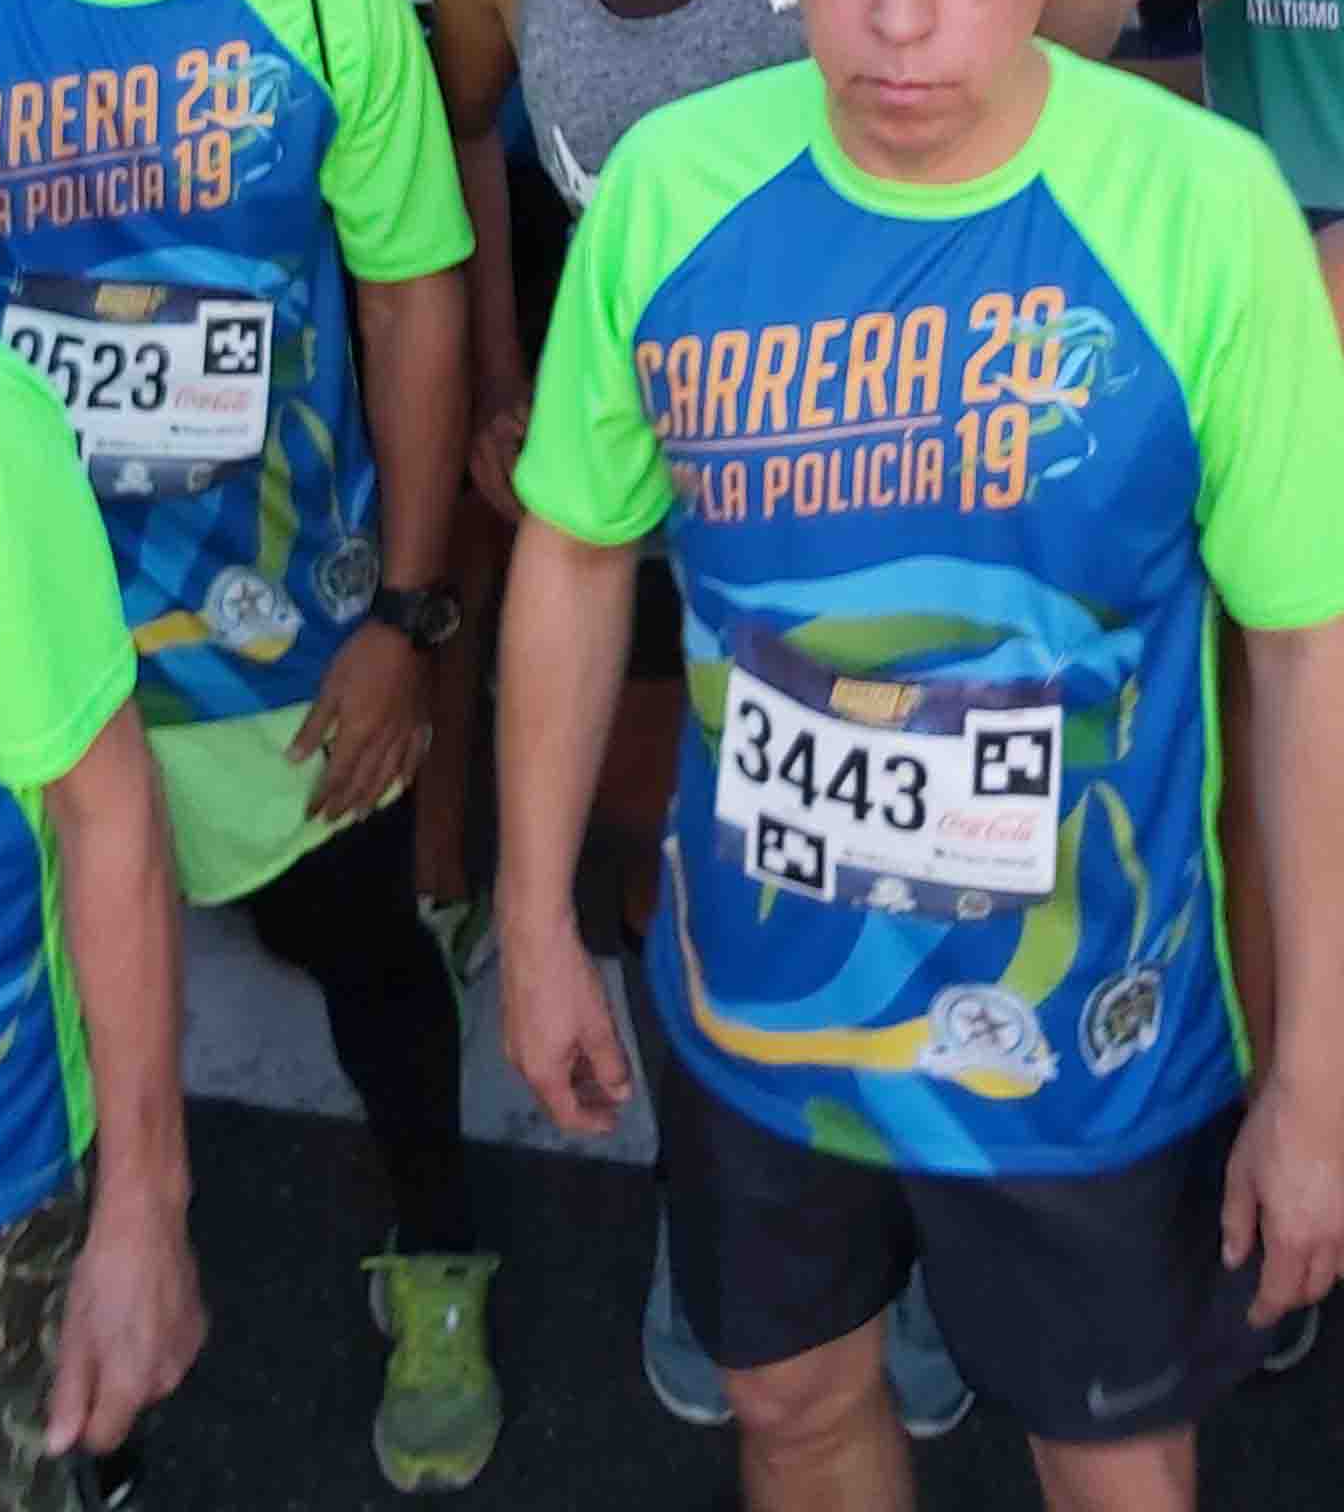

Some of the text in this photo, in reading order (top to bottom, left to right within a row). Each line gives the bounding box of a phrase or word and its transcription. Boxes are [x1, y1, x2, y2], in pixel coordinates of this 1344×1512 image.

[175, 38, 250, 136] 20
[26, 154, 165, 234] POLICÍA
[172, 131, 233, 215] 19
[635, 303, 946, 440] CARRERA
[961, 287, 1067, 406] 20
[702, 460, 748, 522] LA
[763, 426, 944, 520] POLICÍA
[953, 403, 1031, 513] 19
[734, 701, 929, 832] 3443
